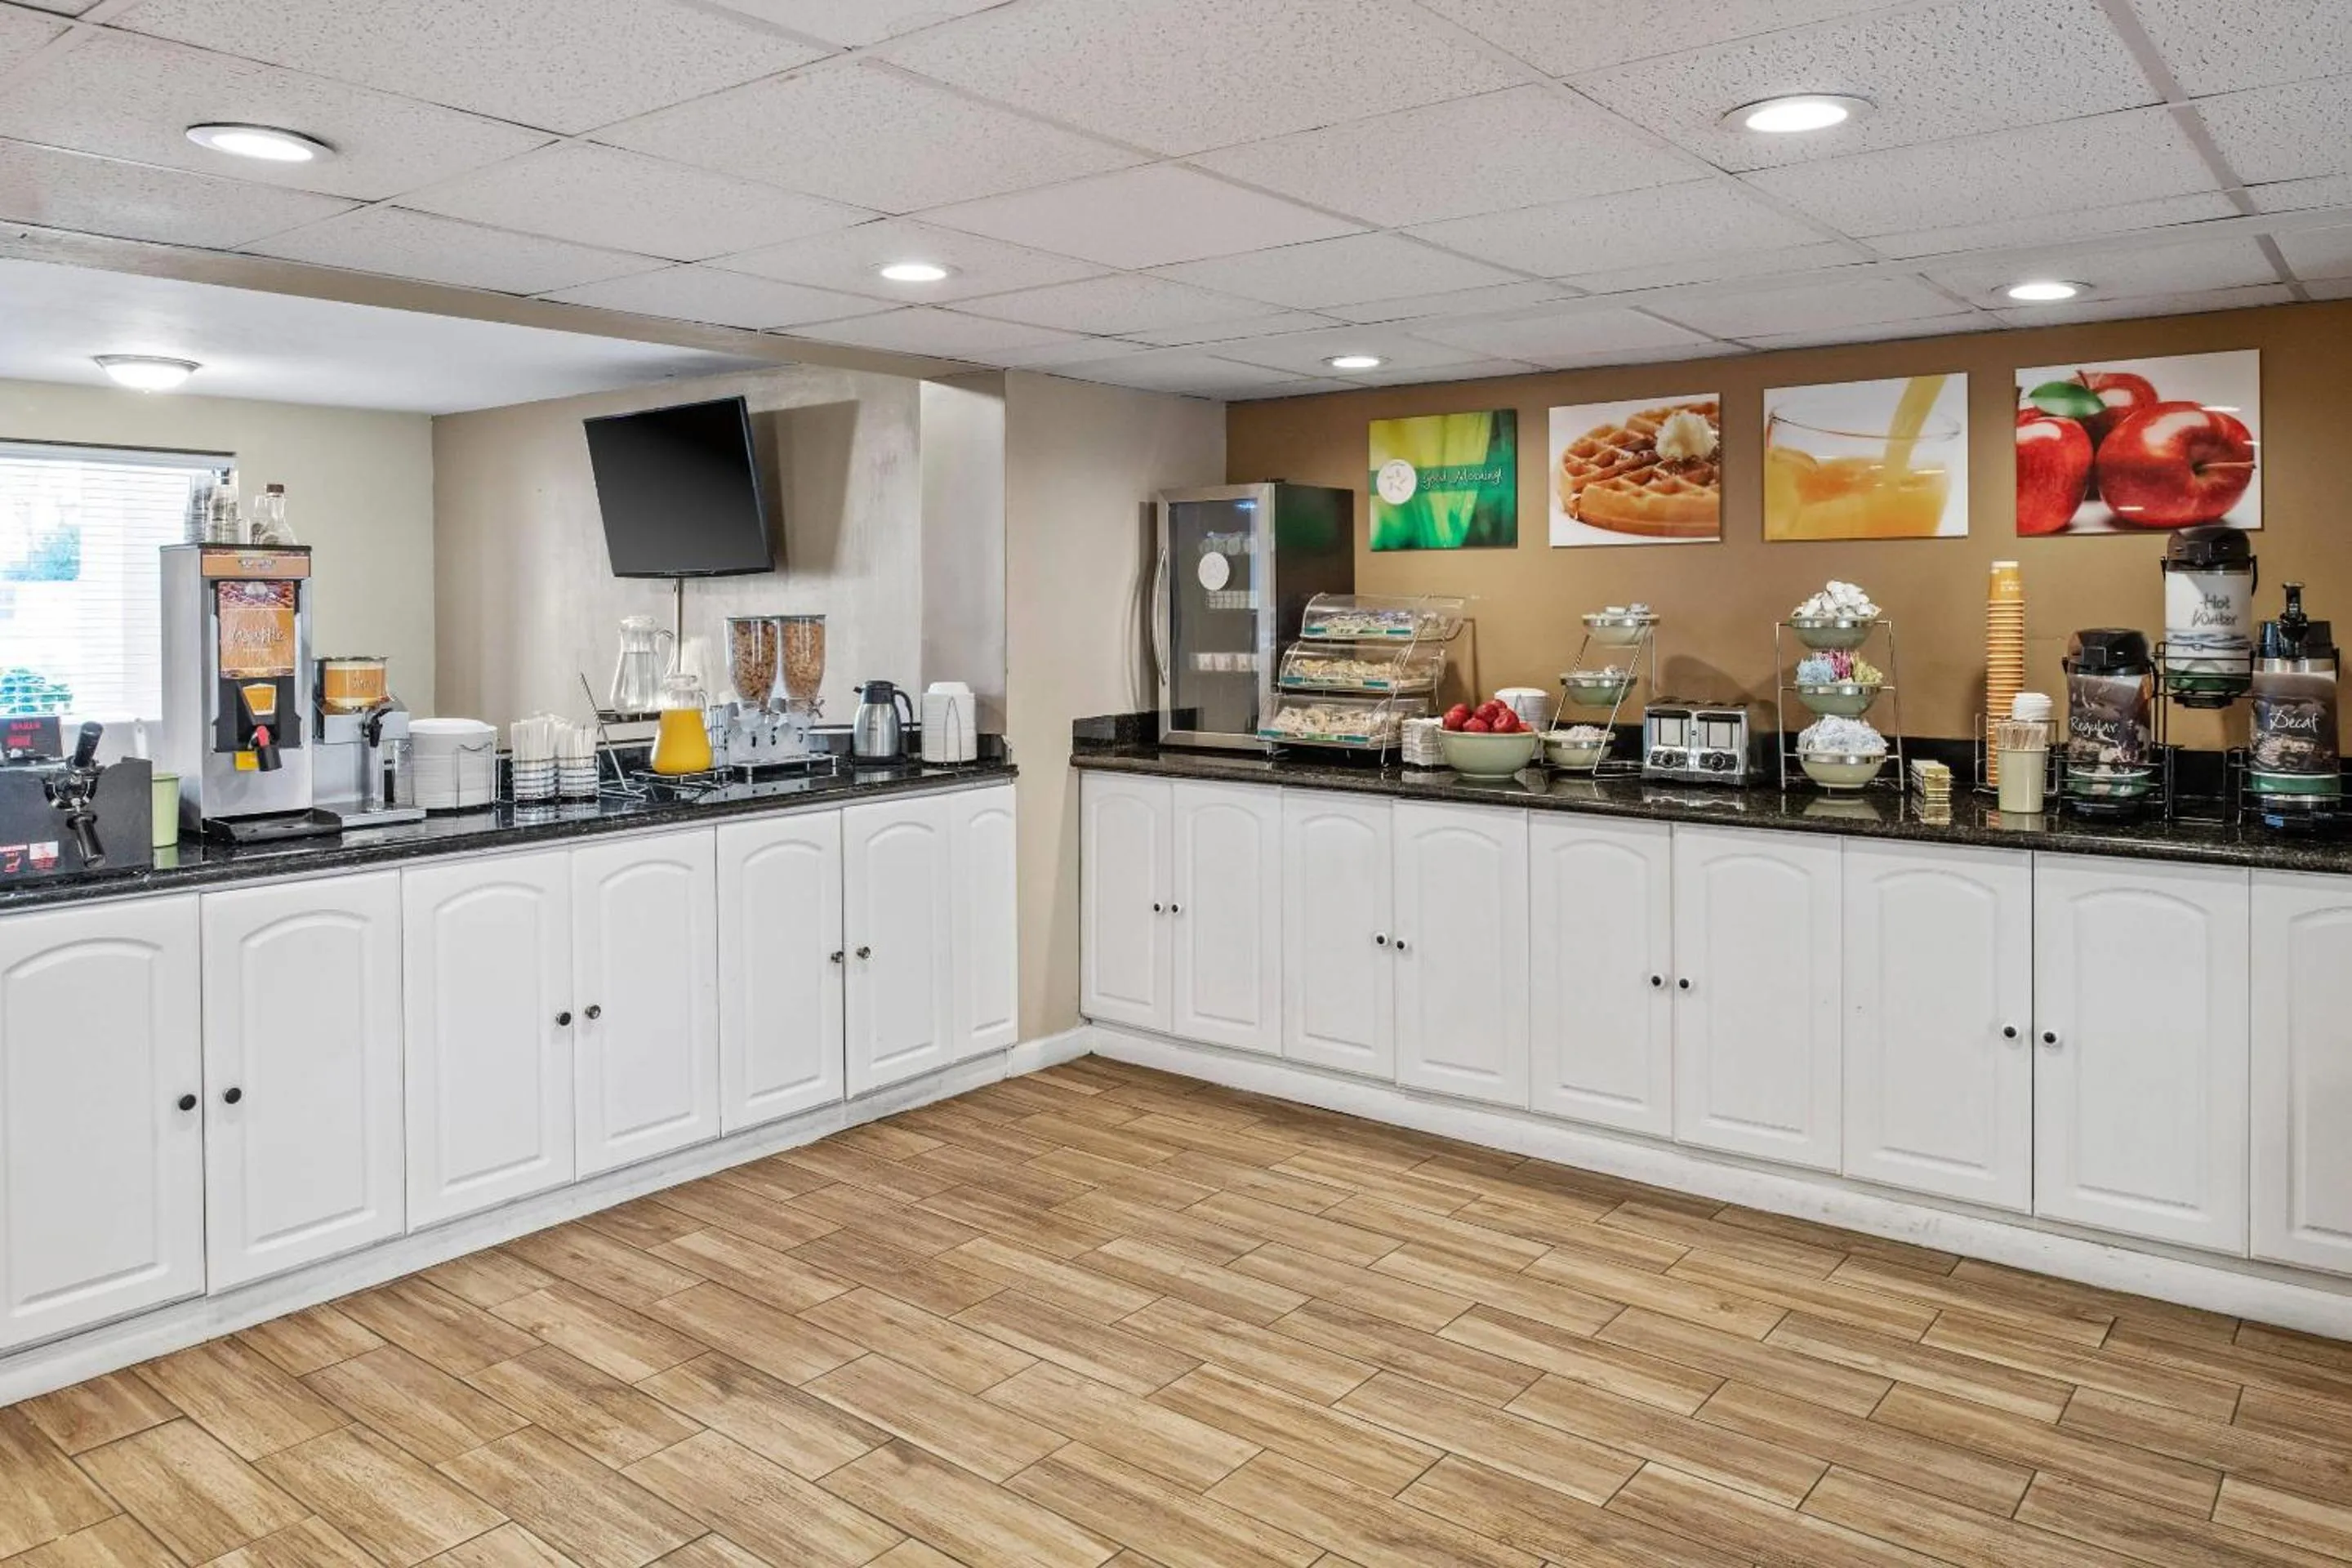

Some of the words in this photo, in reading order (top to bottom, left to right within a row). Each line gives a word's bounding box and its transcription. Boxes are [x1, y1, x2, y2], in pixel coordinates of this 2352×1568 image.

[2200, 593, 2230, 609] Hot
[2192, 608, 2238, 627] Water
[2070, 716, 2118, 737] Regular
[2270, 710, 2319, 733] Decaf
